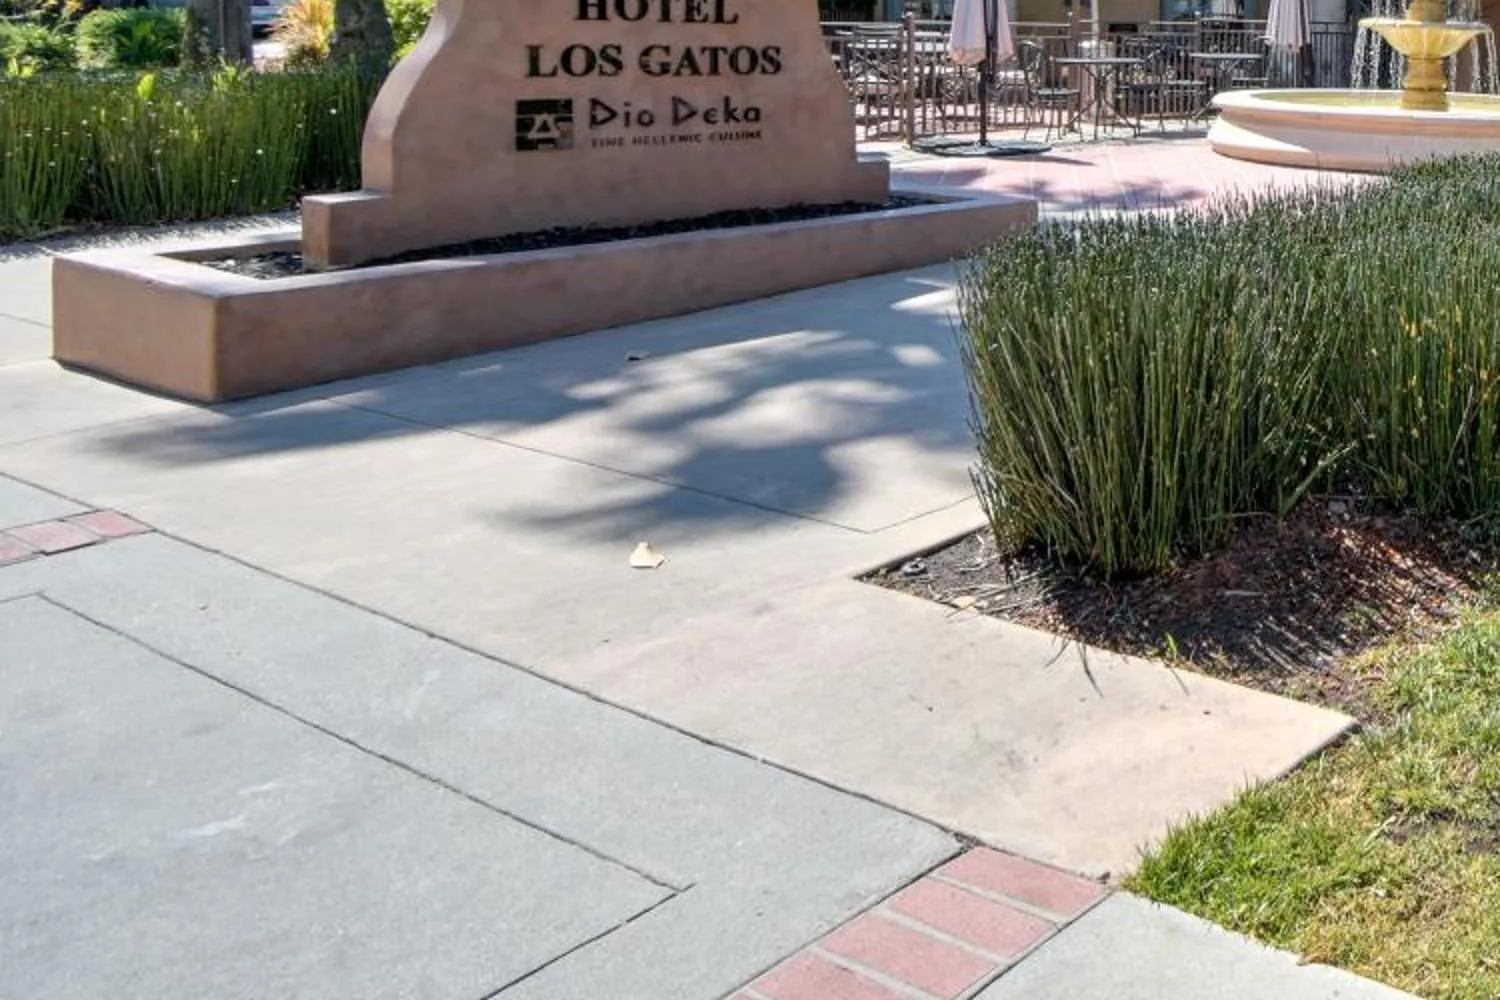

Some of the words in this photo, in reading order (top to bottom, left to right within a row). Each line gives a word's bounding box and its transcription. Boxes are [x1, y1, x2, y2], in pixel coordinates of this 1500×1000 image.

[525, 43, 624, 78] LOS
[638, 44, 783, 78] GATOS
[589, 97, 655, 129] Dio
[671, 95, 762, 127] Deka
[632, 133, 703, 146] HELLENIC
[708, 130, 762, 143] CUISINE
